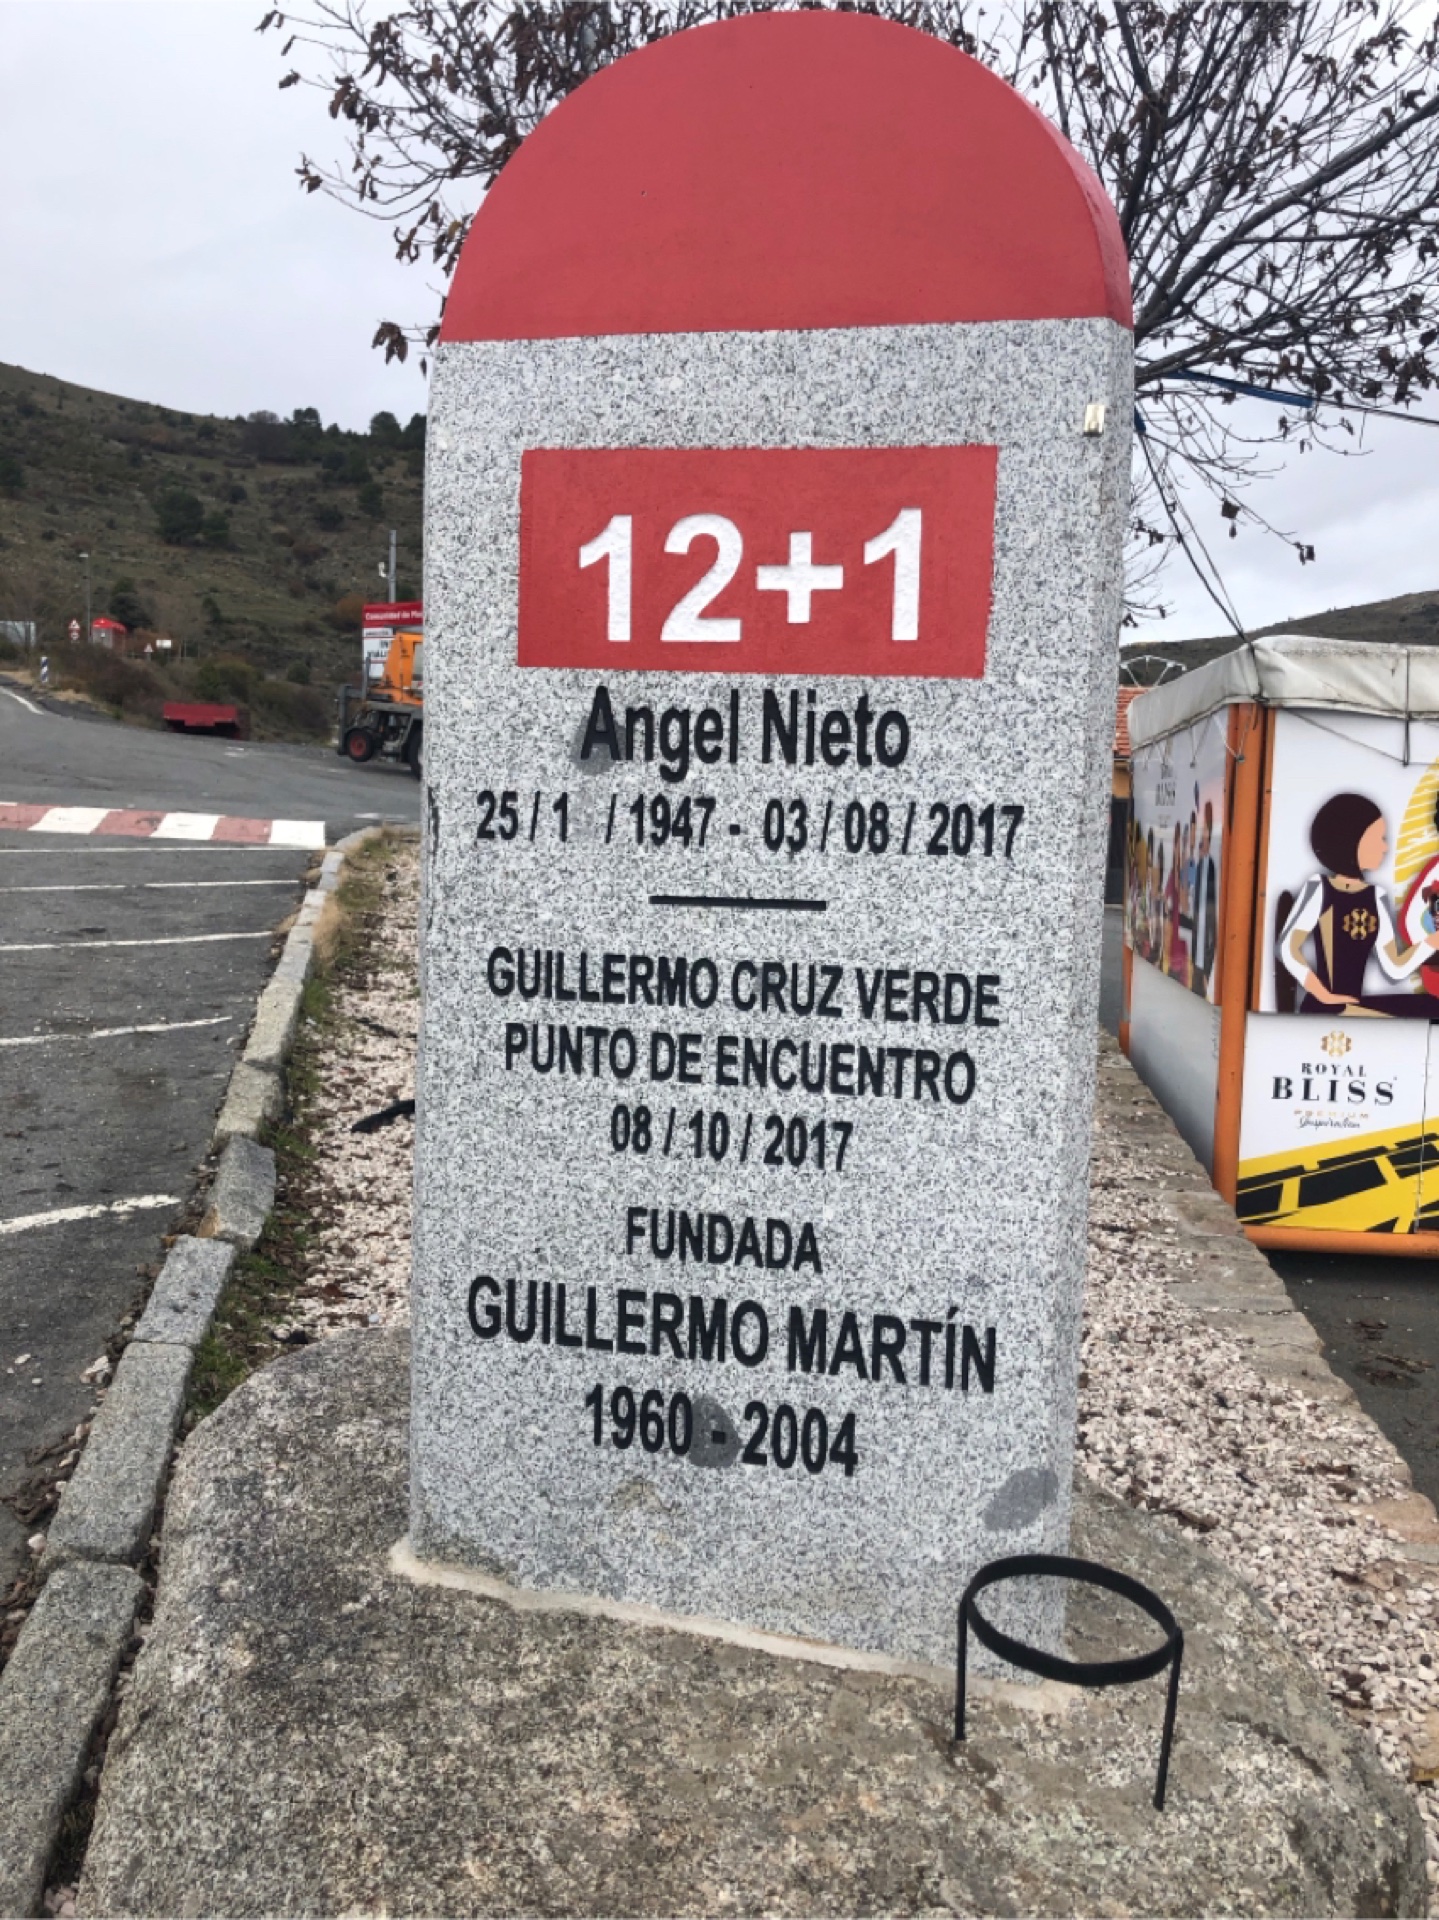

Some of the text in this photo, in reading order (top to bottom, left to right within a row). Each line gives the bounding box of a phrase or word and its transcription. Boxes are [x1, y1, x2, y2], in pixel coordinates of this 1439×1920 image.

[579, 509, 922, 642] 12+1
[579, 685, 910, 783] Angel Nieto
[486, 946, 1000, 1027] GUILLERMO CRUZ VERDE
[505, 1023, 976, 1104] PUNTO DE ENCUENTRO
[1271, 1076, 1395, 1106] BLISS
[1301, 1062, 1367, 1078] ROYAL
[627, 1207, 822, 1273] FUNDADA
[467, 1275, 996, 1393] GUILLERMO MARTÍN
[585, 1384, 693, 1457] 1960
[742, 1401, 858, 1477] 2004
